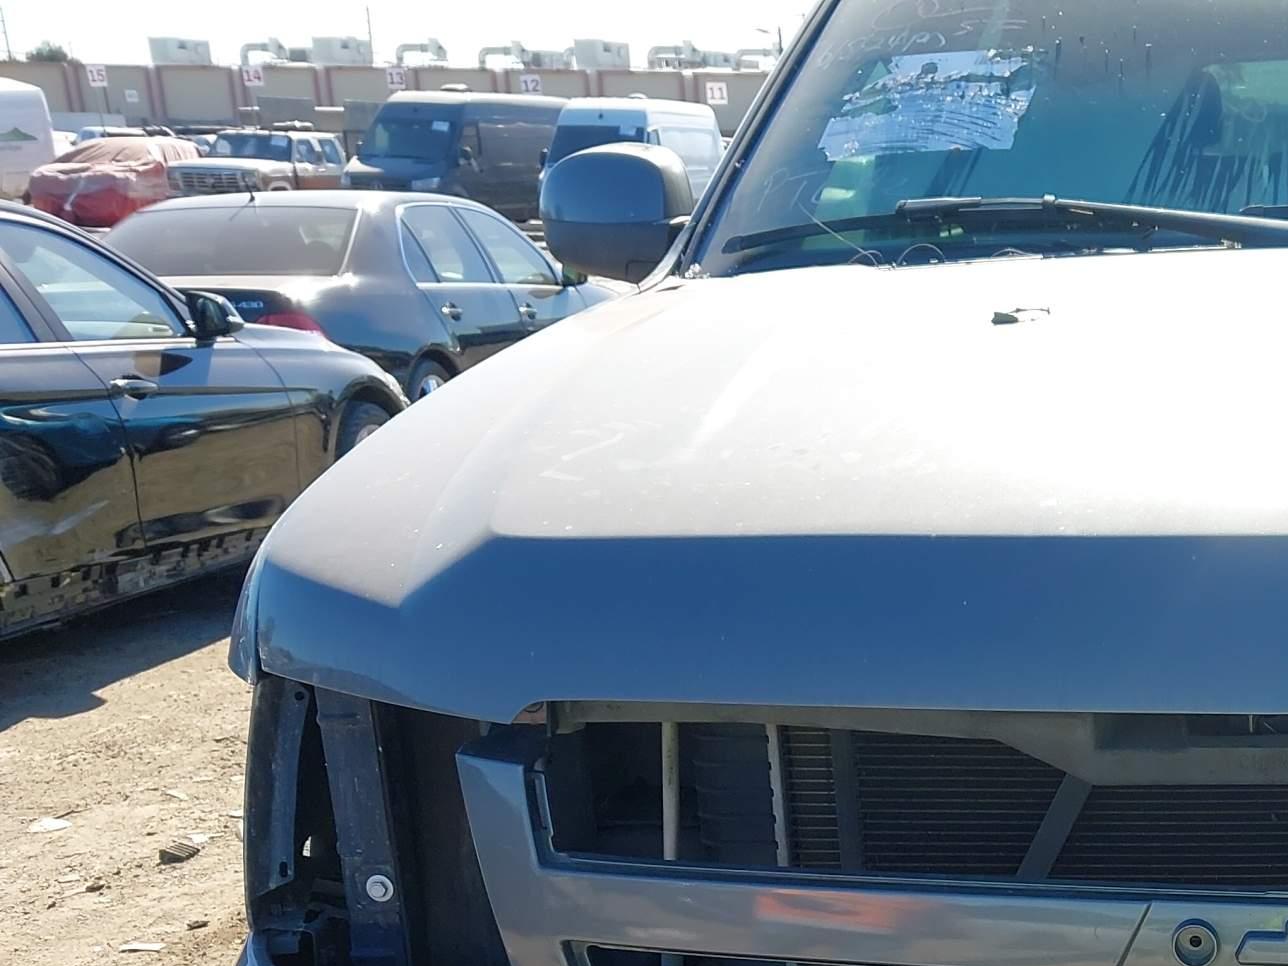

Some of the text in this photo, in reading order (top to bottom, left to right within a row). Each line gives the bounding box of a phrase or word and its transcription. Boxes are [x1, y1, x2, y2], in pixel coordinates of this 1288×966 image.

[88, 69, 105, 82] 15
[245, 69, 262, 82] 14
[388, 71, 404, 85] 13
[523, 79, 541, 92] 12
[709, 87, 726, 100] 11
